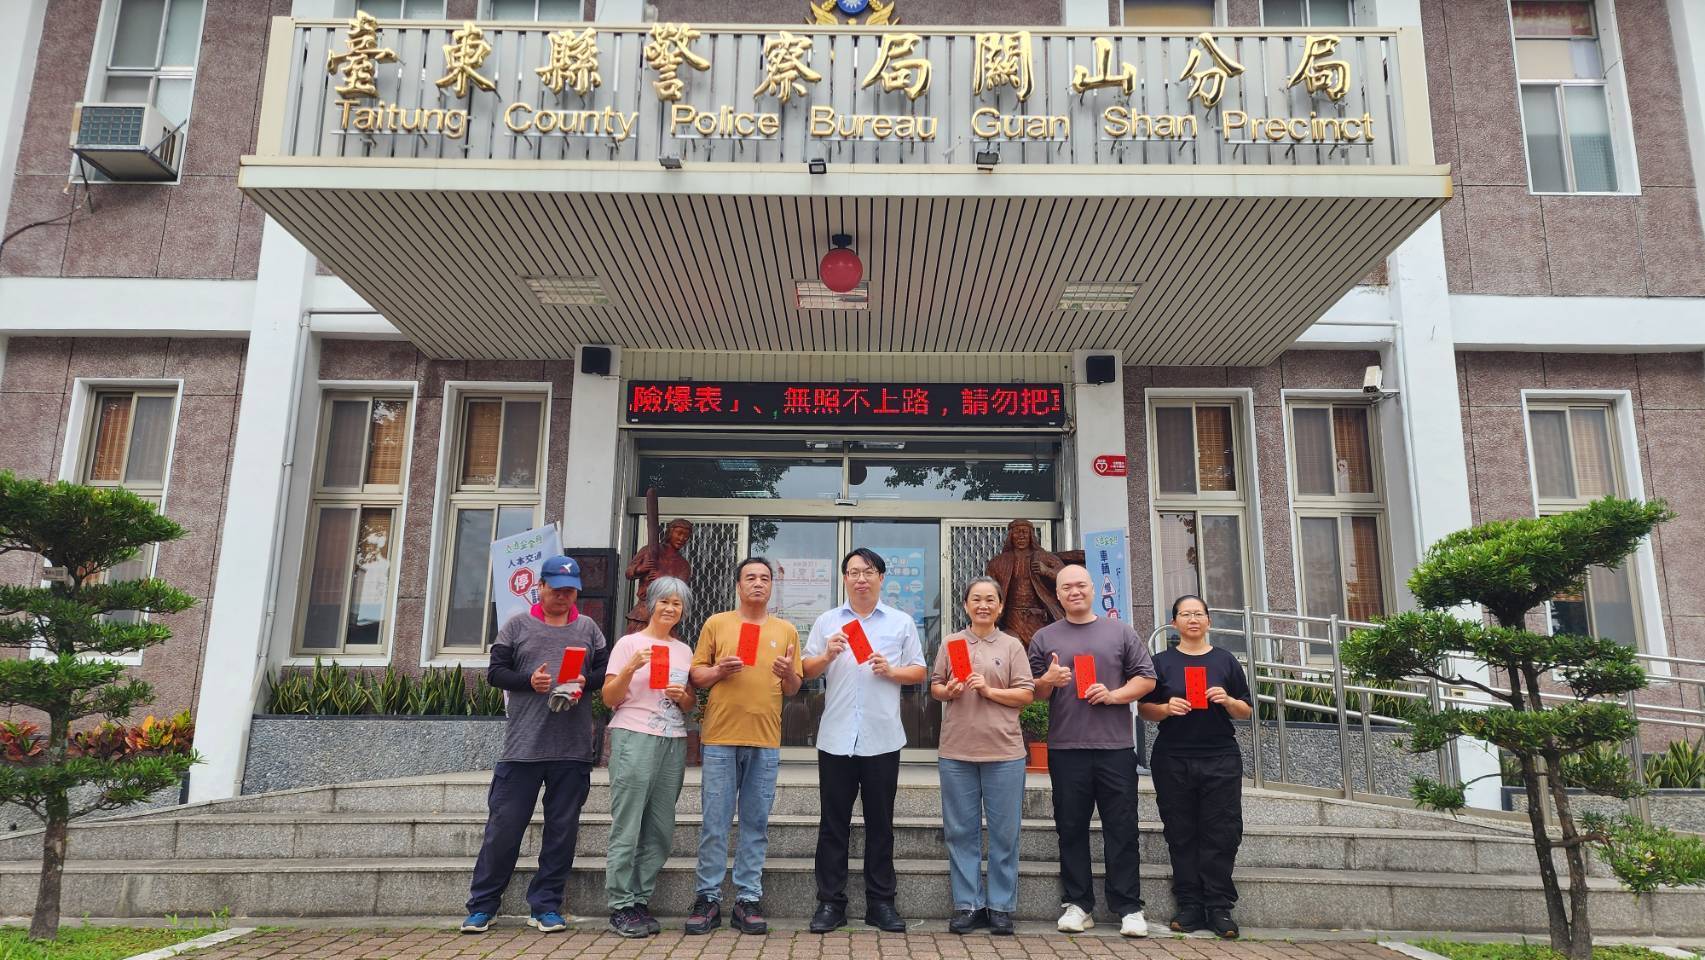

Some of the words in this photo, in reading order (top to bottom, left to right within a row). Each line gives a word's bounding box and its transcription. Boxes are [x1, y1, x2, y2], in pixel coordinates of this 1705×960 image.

[334, 100, 469, 139] Taitung
[504, 102, 638, 142] County
[670, 104, 780, 137] Police
[810, 105, 938, 139] Bureau
[972, 107, 1070, 139] Guan
[1104, 106, 1198, 137] Shan
[1223, 110, 1375, 142] Precinct
